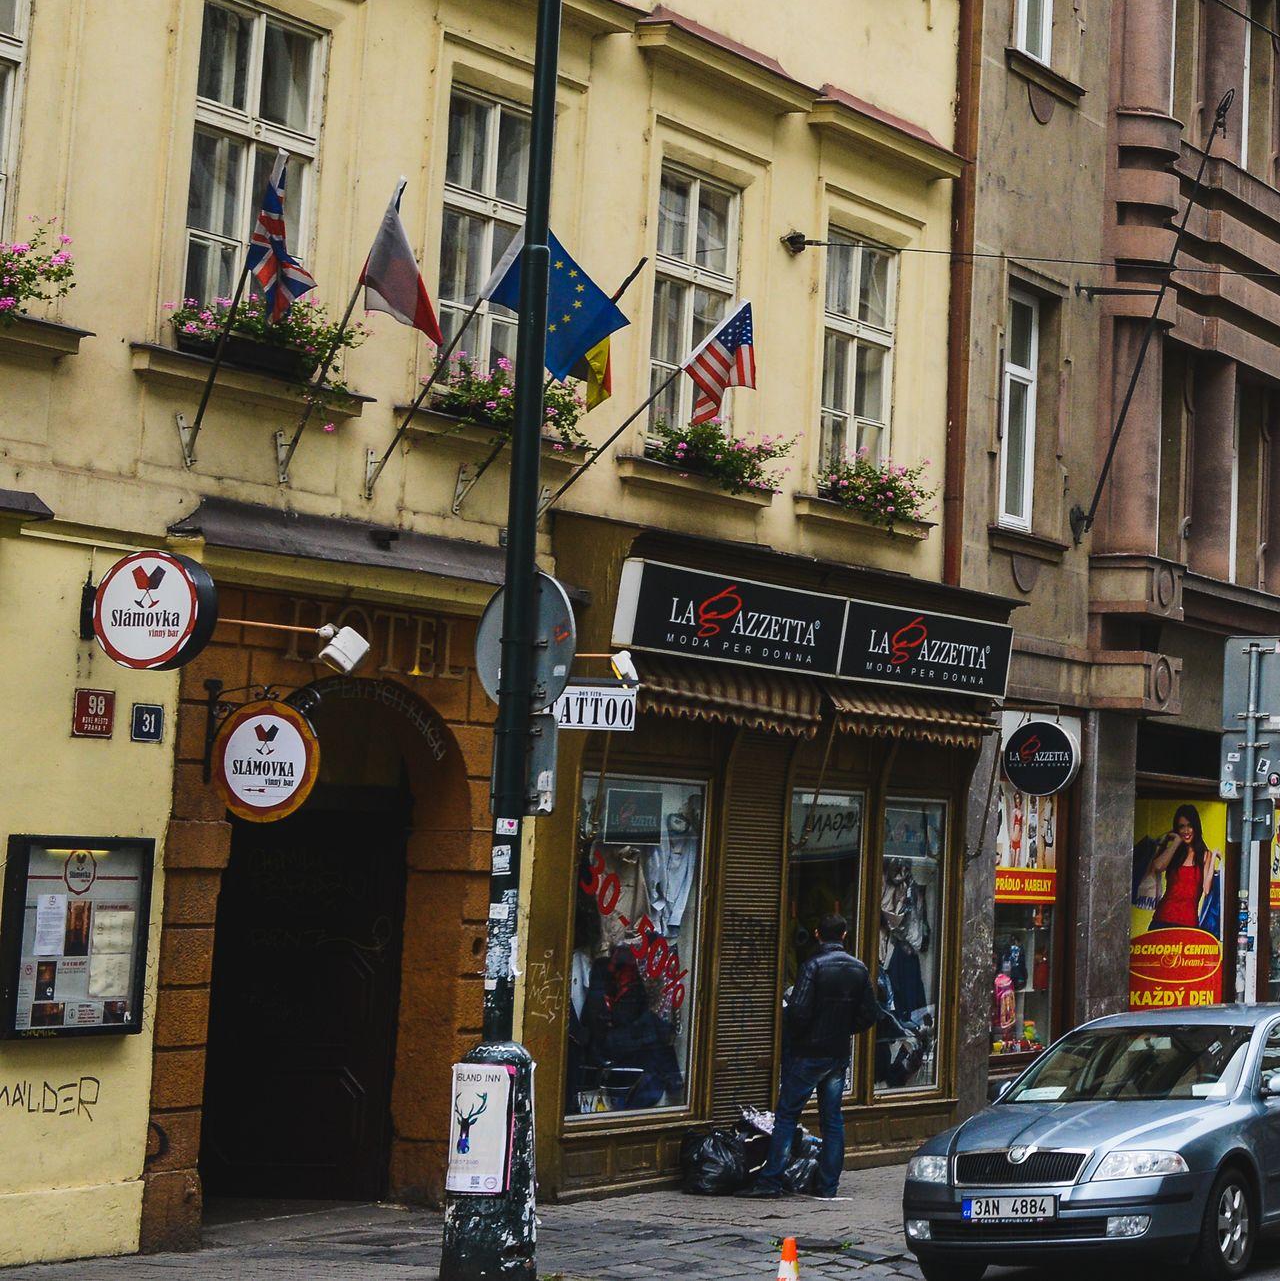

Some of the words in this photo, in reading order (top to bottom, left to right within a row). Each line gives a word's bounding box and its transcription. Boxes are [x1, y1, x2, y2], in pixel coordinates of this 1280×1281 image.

[111, 607, 181, 628] Slámovka
[669, 597, 696, 626] LA
[167, 629, 180, 638] bar
[282, 597, 466, 680] HOTEL
[868, 629, 890, 655] LA
[666, 632, 710, 648] MODA
[722, 641, 752, 654] PER
[762, 647, 812, 664] DONNA
[866, 661, 901, 674] MODA
[911, 667, 935, 678] PER
[943, 671, 985, 685] DONNA
[87, 695, 105, 716] 98
[142, 714, 156, 733] 31
[1009, 751, 1020, 761] LA
[232, 757, 295, 777] SLÁMOVKA
[283, 777, 295, 787] bar
[995, 875, 1021, 891] PRÁDLO
[1024, 878, 1052, 892] KABELKY
[1129, 941, 1183, 955] OBCHODNÍ
[1184, 944, 1219, 955] CENTRUM
[1160, 955, 1205, 968] Dreams
[1129, 986, 1186, 1006] KAŽDÝ
[1189, 990, 1214, 1006] DEN
[485, 1073, 501, 1082] INN
[975, 1199, 1000, 1216] 3AN
[1011, 1198, 1047, 1215] 4884
